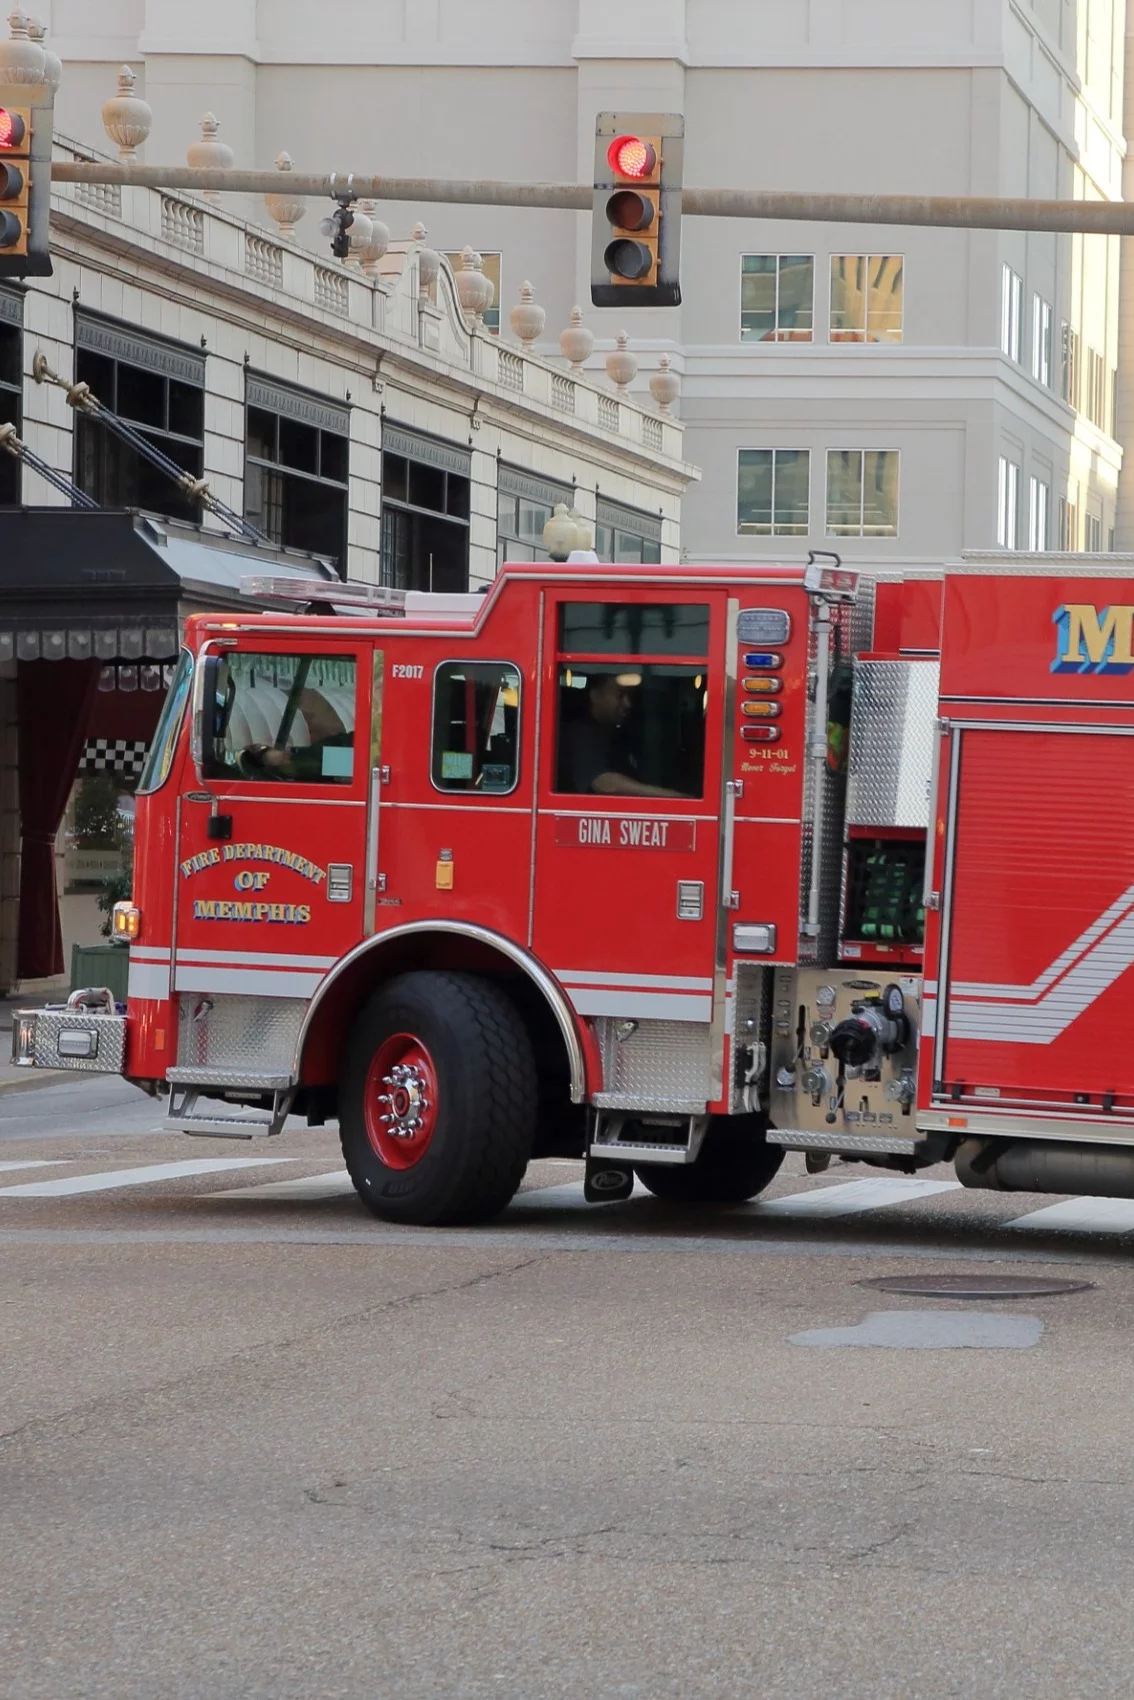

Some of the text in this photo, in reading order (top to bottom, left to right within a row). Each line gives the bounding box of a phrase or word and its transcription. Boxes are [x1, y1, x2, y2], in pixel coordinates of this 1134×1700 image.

[392, 664, 424, 679] F2017
[748, 748, 788, 759] 9-11-01
[578, 818, 669, 846] GINA SWEAT
[180, 843, 327, 884] FIRE DEPARTMENT
[234, 871, 270, 891] OF
[193, 900, 311, 925] MEMPHIS
